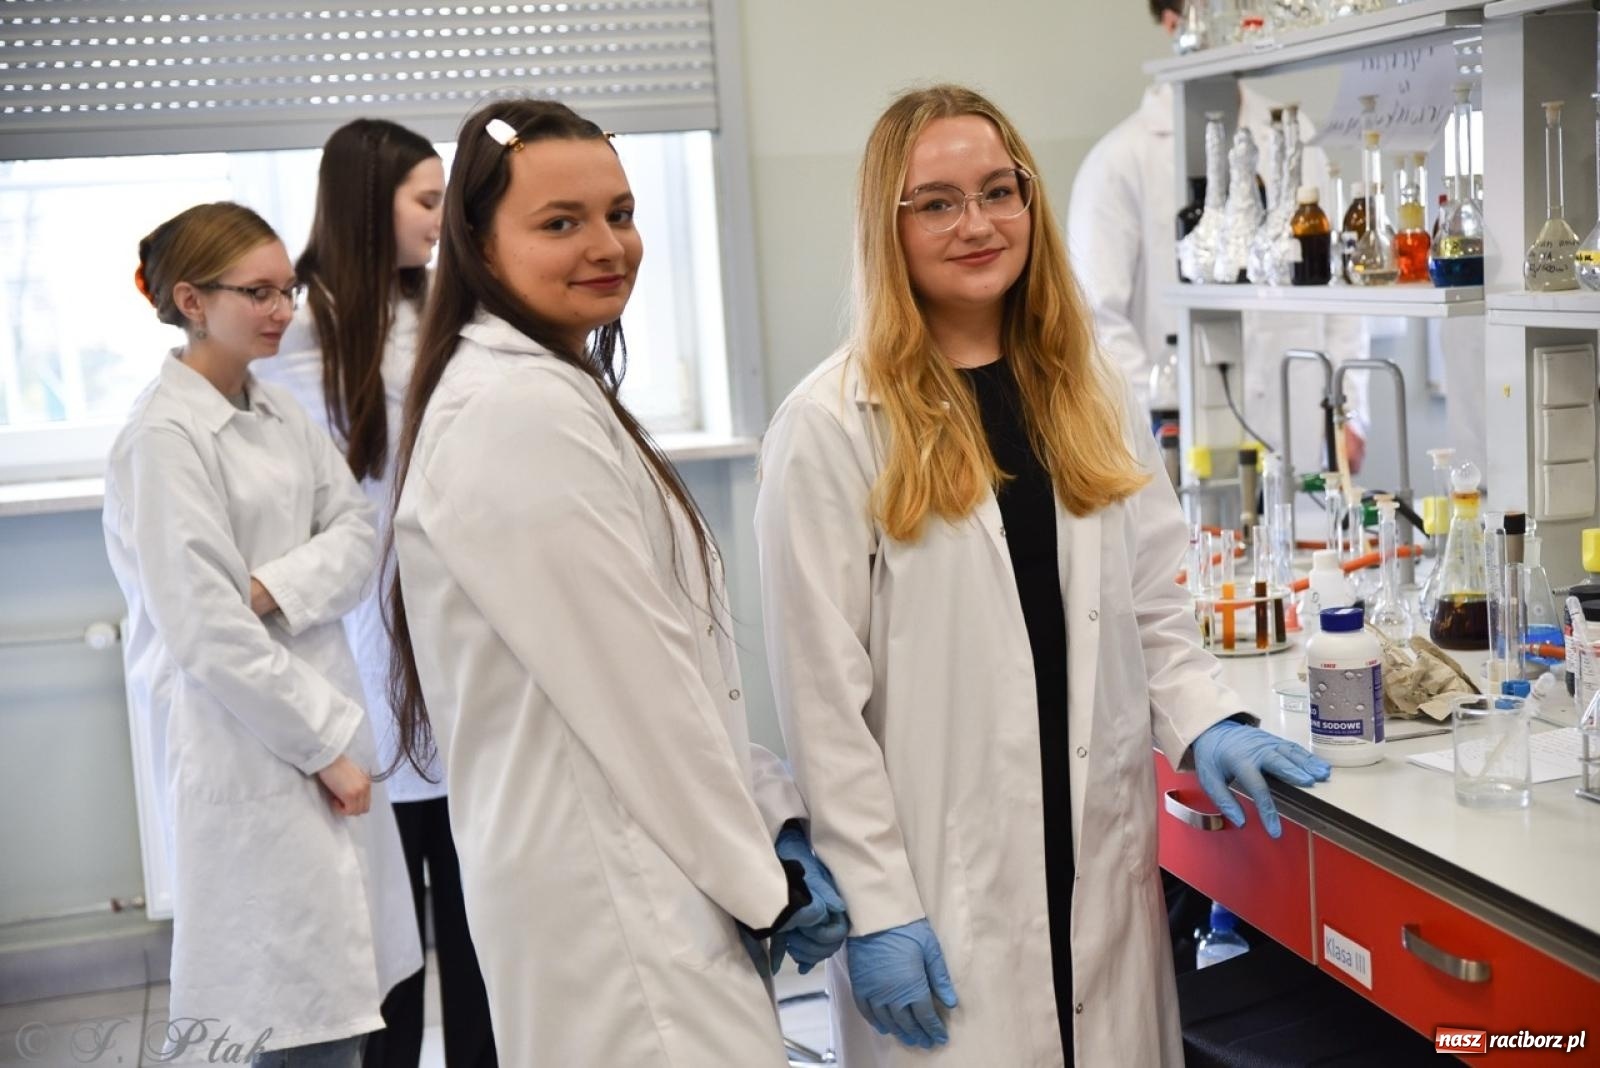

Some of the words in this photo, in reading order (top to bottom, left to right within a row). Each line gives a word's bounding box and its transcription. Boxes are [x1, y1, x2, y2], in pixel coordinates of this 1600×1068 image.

[1322, 722, 1361, 730] SODOWE
[1326, 936, 1352, 967] Klasa
[1355, 951, 1366, 976] III
